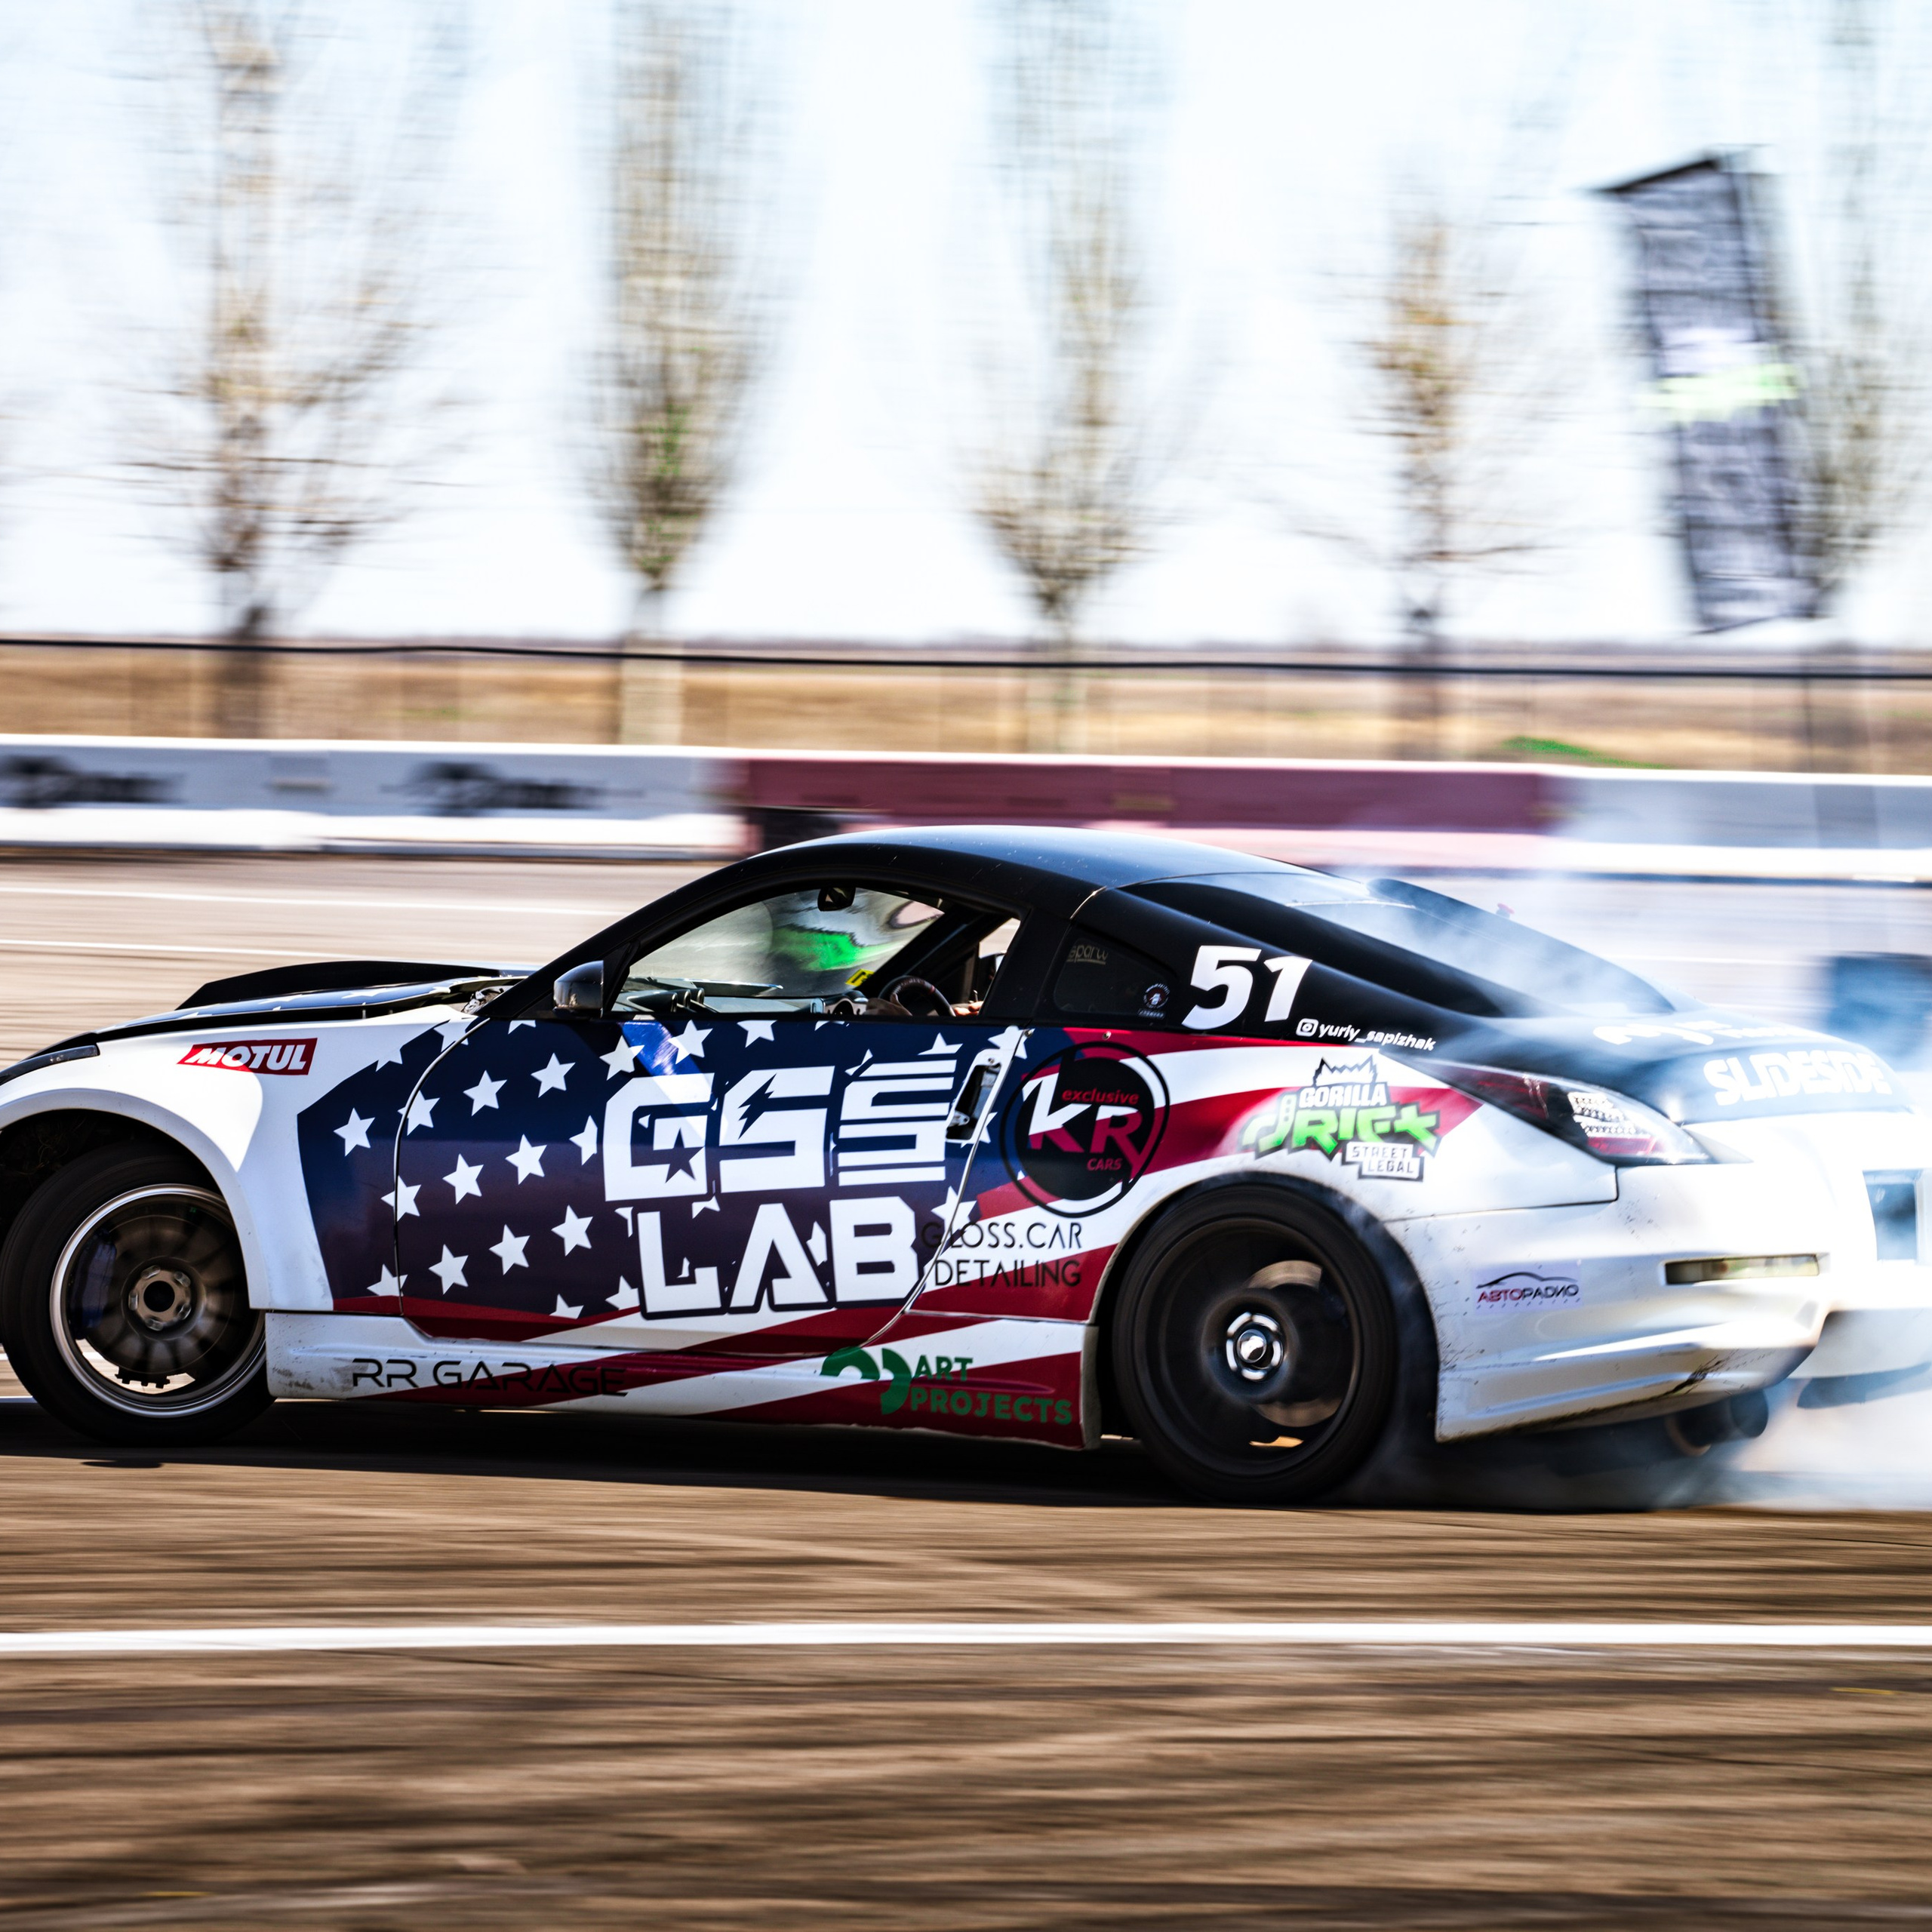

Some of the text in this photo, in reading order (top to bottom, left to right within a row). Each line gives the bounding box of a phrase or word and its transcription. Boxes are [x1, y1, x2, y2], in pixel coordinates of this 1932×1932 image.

[1182, 945, 1312, 1029] 51
[184, 1045, 306, 1071] MOTUL
[1703, 1050, 1893, 1106] SLIDESIDE
[1061, 1088, 1140, 1105] exclusive
[1299, 1084, 1387, 1108] GORILLA
[1087, 1158, 1123, 1171] CARS
[1352, 1146, 1407, 1158] STREET
[1367, 1160, 1414, 1174] LEGAL
[637, 1196, 919, 1313] LAB
[935, 1260, 1081, 1287] DETAILING
[1477, 1284, 1580, 1303] АВТОРАДИО
[352, 1358, 628, 1397] RR GARAGE
[913, 1355, 974, 1382] ART
[910, 1387, 1074, 1425] PROJECTS
